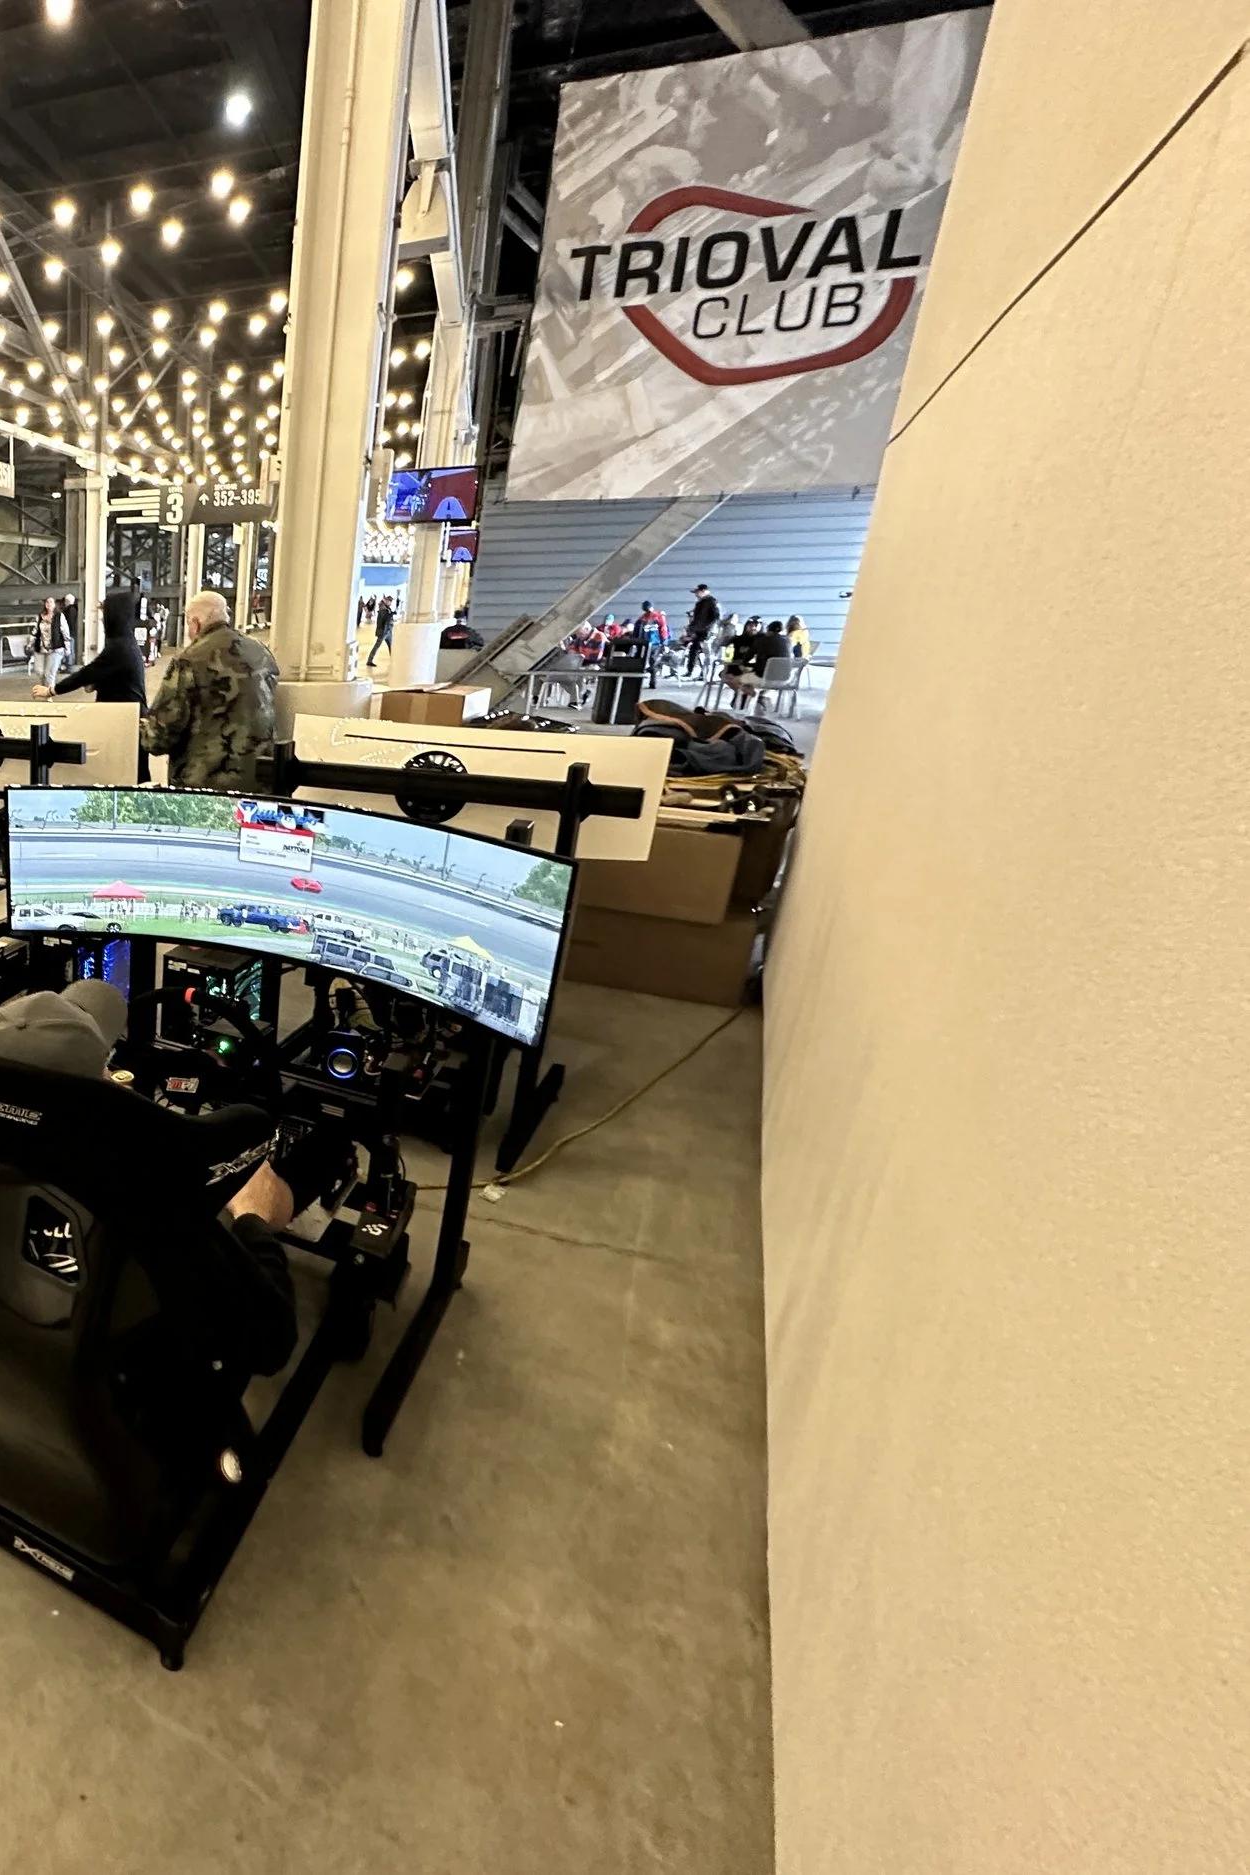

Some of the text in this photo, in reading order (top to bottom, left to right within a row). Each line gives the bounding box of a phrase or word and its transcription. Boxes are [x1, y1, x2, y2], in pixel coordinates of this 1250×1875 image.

[570, 209, 922, 301] TRIOVAL
[692, 282, 864, 340] CLUB
[166, 493, 184, 524] 3
[213, 488, 261, 507] 352-395
